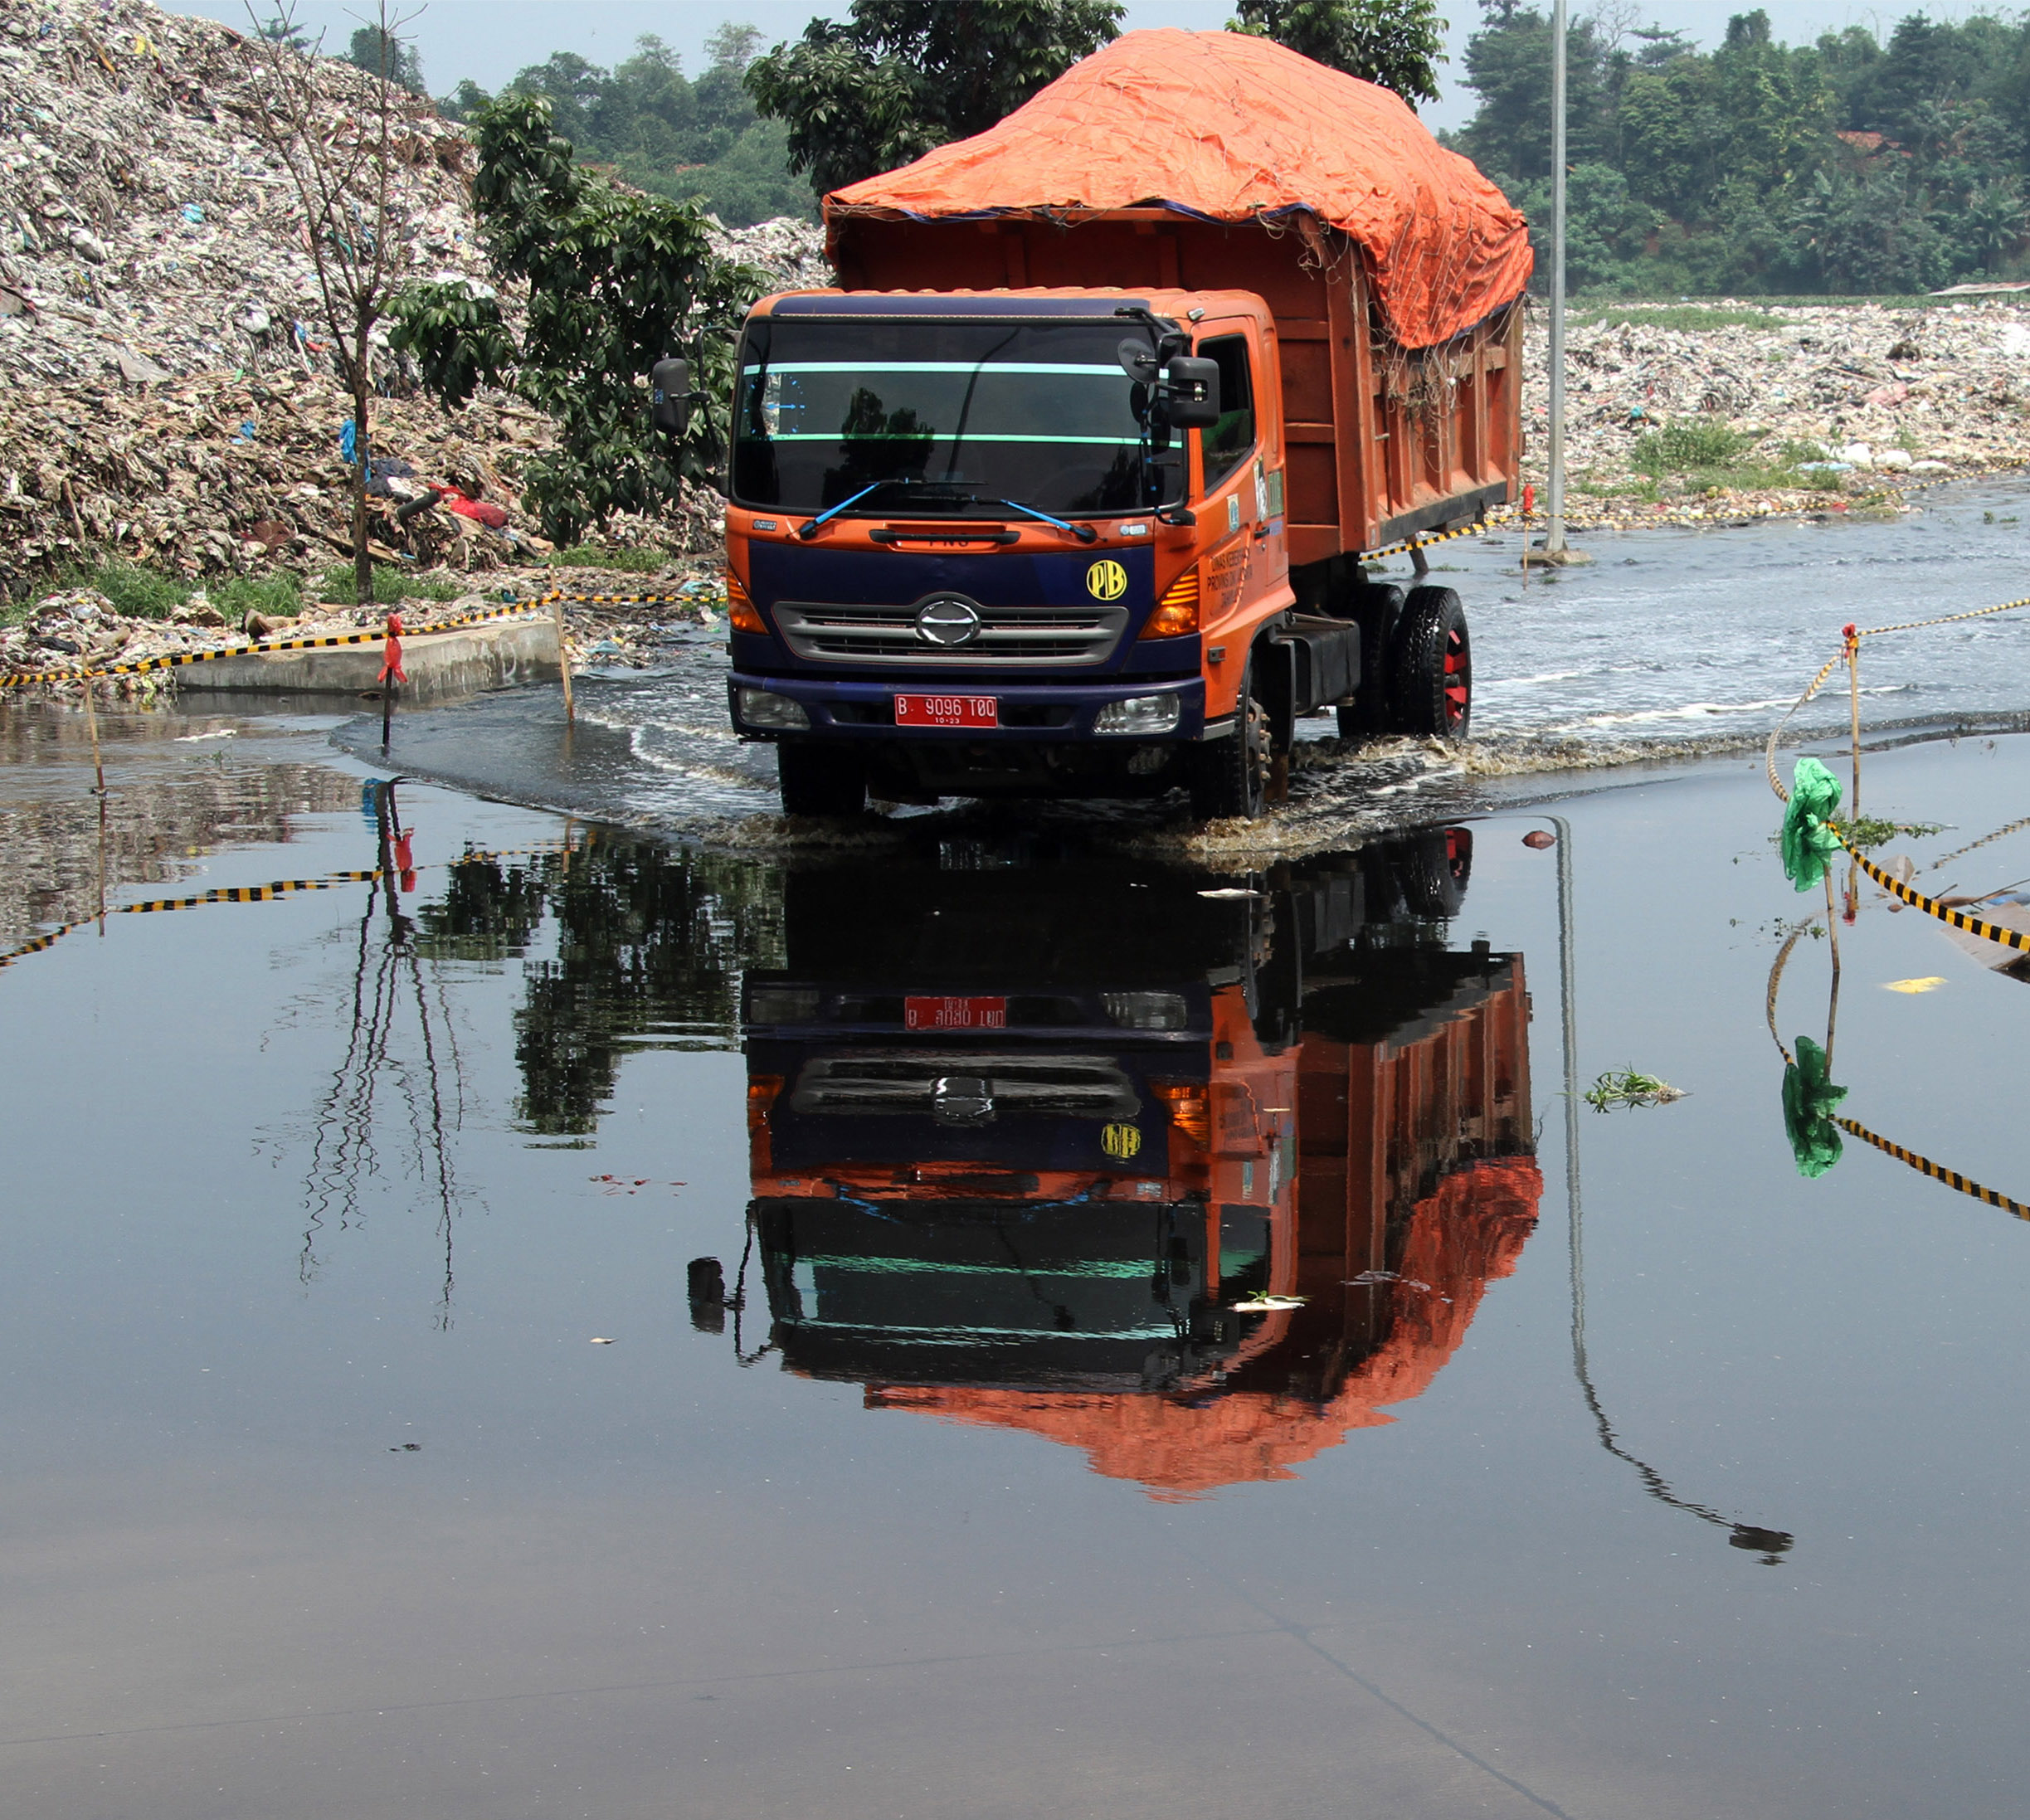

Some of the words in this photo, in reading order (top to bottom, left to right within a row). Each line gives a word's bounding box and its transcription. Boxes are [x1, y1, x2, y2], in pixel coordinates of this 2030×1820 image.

[1088, 561, 1126, 599] PB
[897, 697, 908, 715] B
[925, 698, 962, 716] 9096
